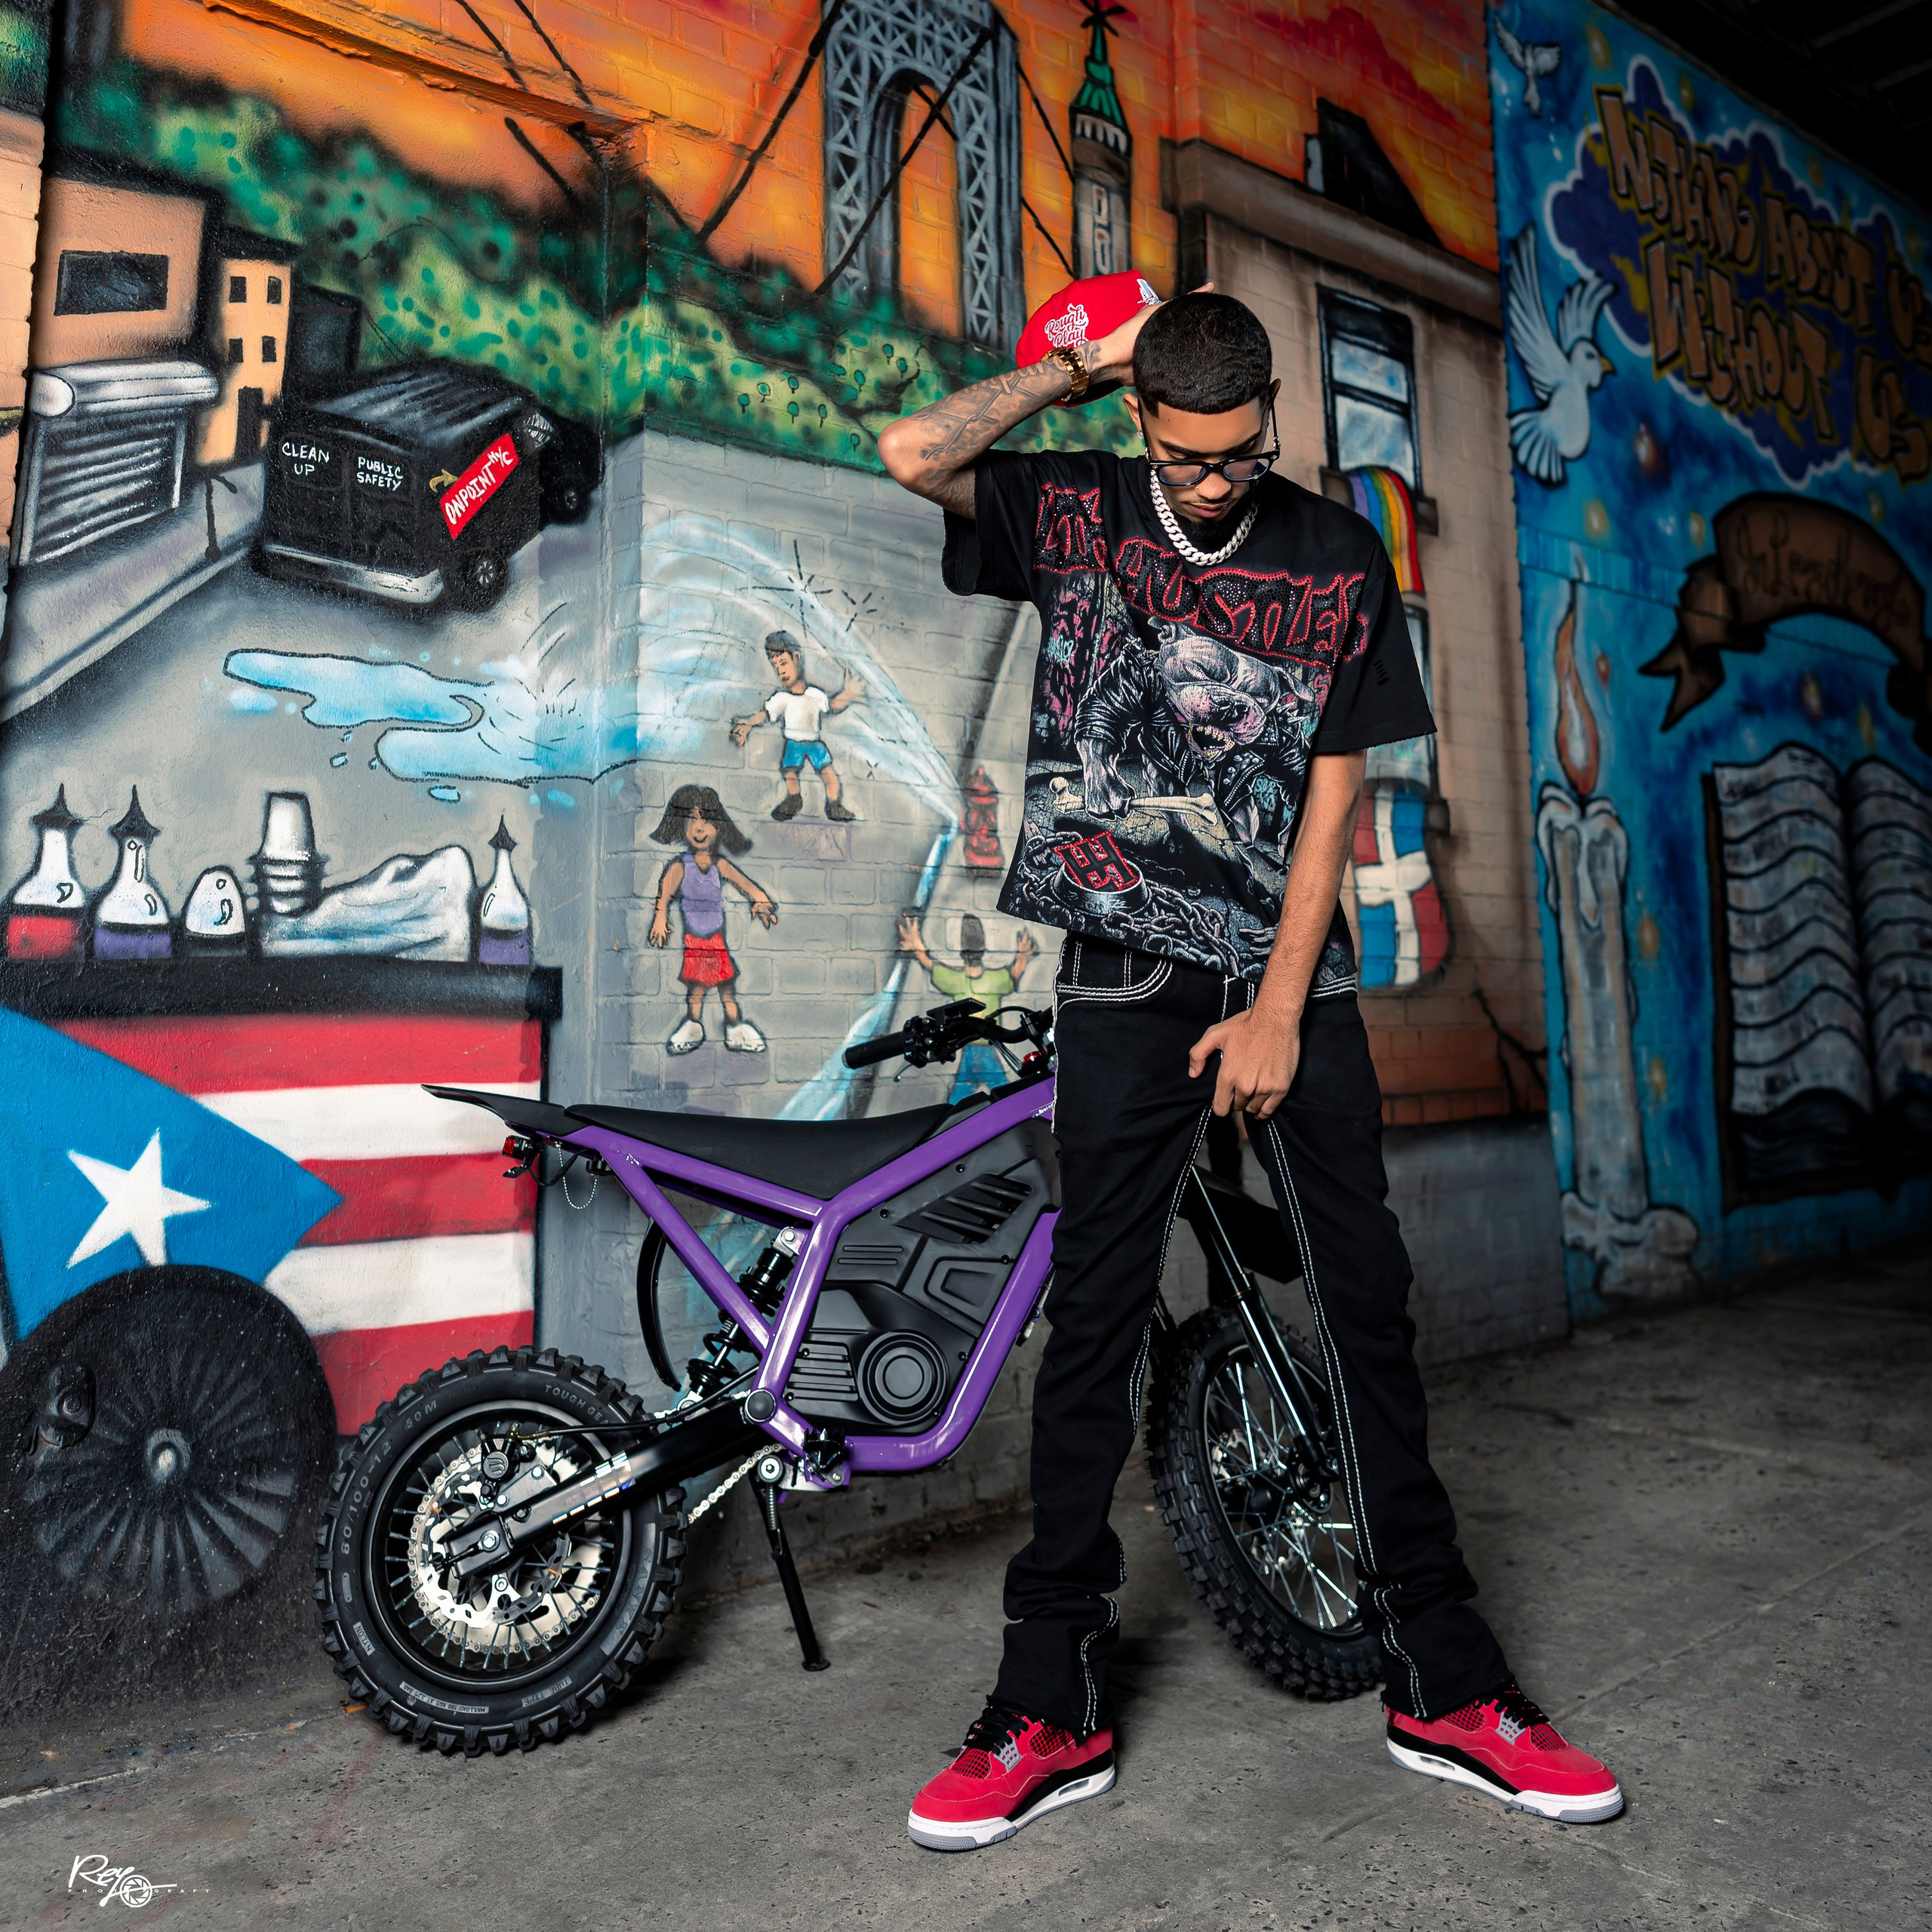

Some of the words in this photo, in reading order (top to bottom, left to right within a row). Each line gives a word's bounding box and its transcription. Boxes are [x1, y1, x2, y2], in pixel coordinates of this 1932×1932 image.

[1594, 88, 1756, 268] NOTHING
[1763, 190, 1875, 331] ABOUT
[1645, 237, 1837, 441] WITHOUT
[1856, 350, 1931, 483] US
[281, 441, 331, 463] CLEAN
[294, 462, 315, 476] UP
[358, 456, 404, 480] PUBLIC
[356, 470, 402, 492] SAFETY
[445, 461, 497, 525] ONPOINT
[544, 1383, 586, 1408] TOUGH
[586, 1405, 609, 1426] GEA
[340, 1440, 392, 1555] 80/100-12
[354, 1625, 373, 1652] NYLON
[402, 1684, 414, 1695] BAR
[524, 1691, 545, 1705] TYPE
[549, 1679, 569, 1694] TUBE
